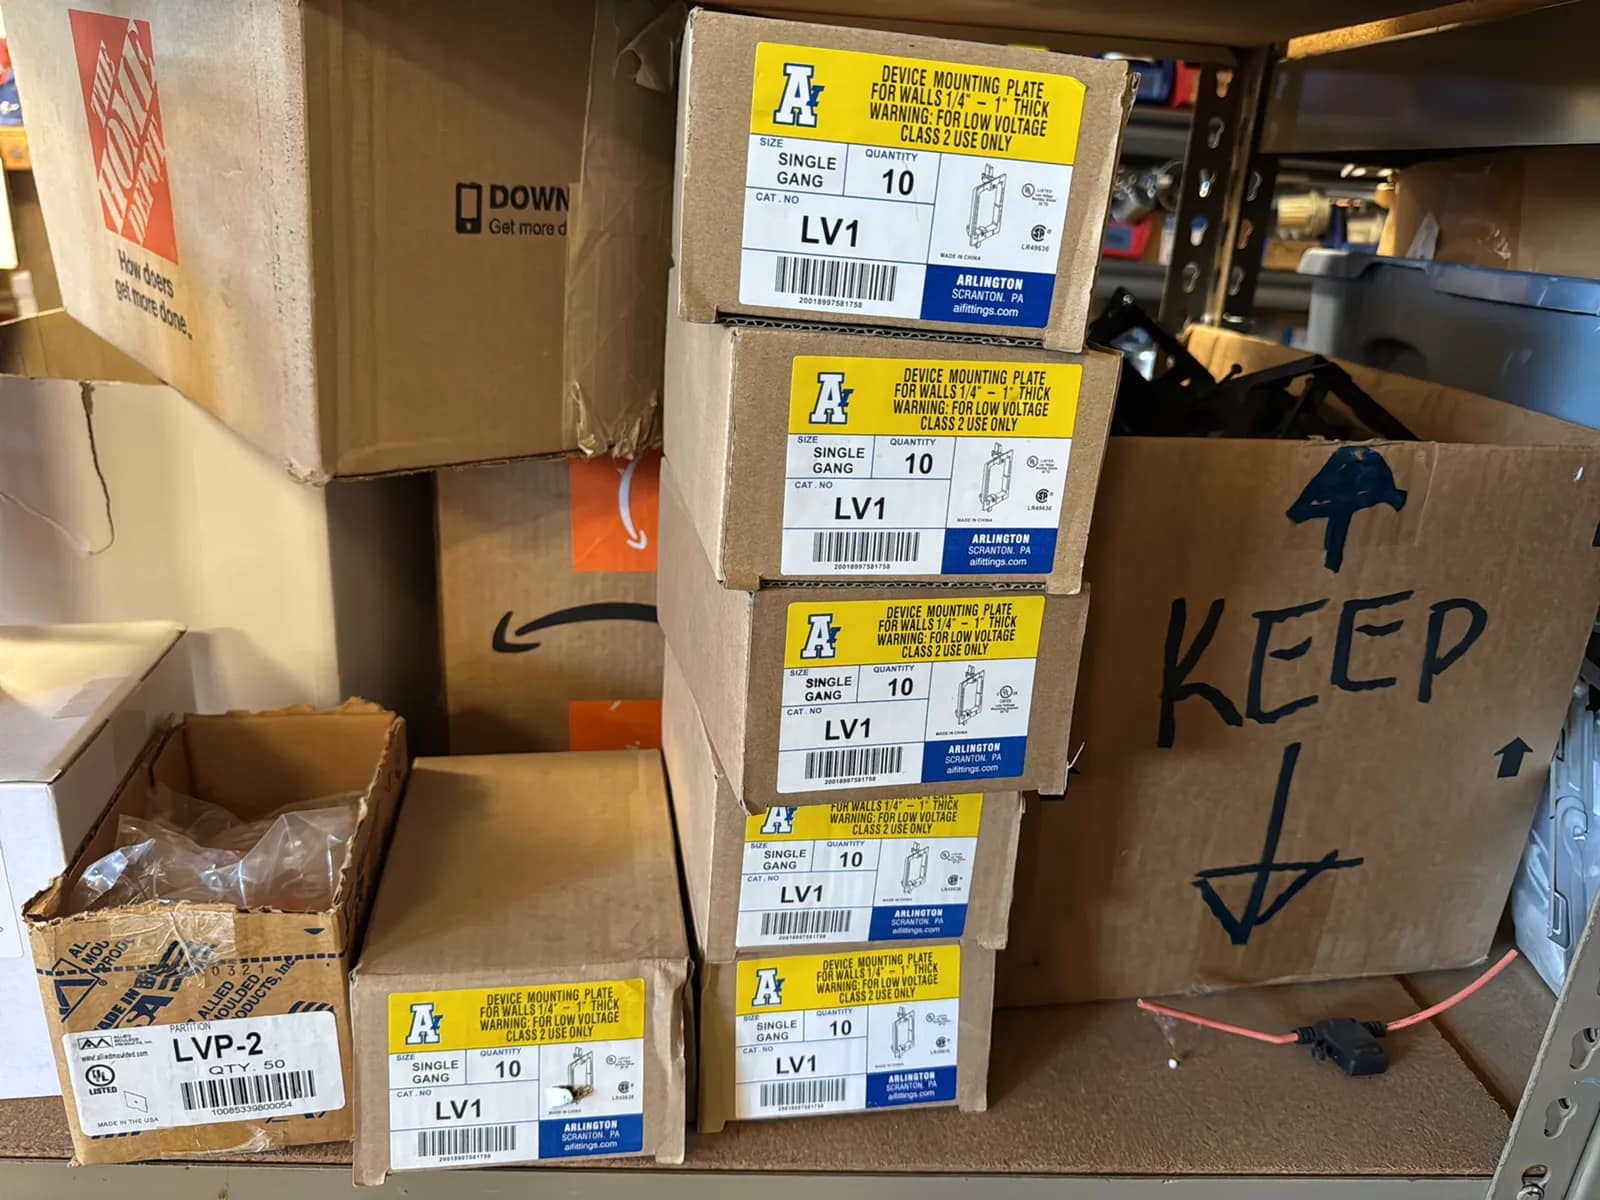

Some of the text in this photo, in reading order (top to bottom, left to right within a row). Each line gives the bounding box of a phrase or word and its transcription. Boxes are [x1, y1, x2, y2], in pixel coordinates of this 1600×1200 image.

[91, 39, 115, 128] THE
[881, 65, 1044, 99] DEVICE MOUNTING PLATE
[870, 83, 898, 102] FOR
[899, 86, 942, 106] WALLS
[1012, 98, 1049, 117] THICK
[98, 18, 158, 236] HOME
[869, 103, 1047, 136] WARNING: FOR LOW VOLTAGE
[759, 138, 783, 148] SIZE
[900, 125, 1012, 152] CLASS 2 USE ONLY
[778, 153, 837, 170] SINGLE
[864, 149, 917, 163] QUANTITY
[128, 113, 167, 246] DEPOT
[776, 171, 824, 187] GANG
[880, 168, 915, 195] 10
[490, 184, 569, 212] DOWN
[489, 218, 515, 234] Get
[520, 222, 554, 235] more
[801, 215, 858, 247] LV1
[118, 249, 174, 298] How doers
[956, 274, 1023, 290] ARLINGTON
[115, 279, 131, 302] get
[132, 288, 158, 318] more
[1011, 293, 1024, 303] PA
[952, 301, 1019, 318] aifittings.com
[903, 368, 1045, 385] DEVICE MOUNTING PLATE
[893, 400, 1048, 416] WARNING: FOR LOW VOLTAGE
[920, 416, 1018, 431] CLASS 2 USE ONLY
[889, 438, 935, 446] QUANTITY
[813, 447, 865, 458] SINGLE
[812, 463, 854, 473] GANG
[904, 453, 934, 473] 10
[835, 497, 885, 519] LV1
[971, 534, 1029, 543] ARLINGTON
[1019, 546, 1031, 554] PA
[968, 557, 1026, 566] aifittings.com
[885, 603, 1012, 618] DEVICE MOUNTING PLATE
[877, 629, 1015, 645] WARNING: FOR LOW VOLTAGE
[901, 643, 988, 658] CLASS 2 USE ONLY
[874, 665, 915, 673] QUANTITY
[1158, 590, 1487, 748] KEEP
[805, 677, 852, 687] SINGLE
[887, 678, 914, 696] 10
[804, 690, 842, 701] GANG
[825, 718, 870, 740] LV1
[948, 743, 1000, 753] ARLINGTON
[946, 762, 998, 773] aifittings.com
[829, 812, 957, 824] WARNING: FOR LOW VOLTAGE
[852, 824, 932, 834] CLASS 2 USE ONLY
[764, 850, 806, 858] SINGLE
[838, 851, 863, 867] 10
[762, 861, 797, 869] GANG
[780, 885, 822, 903] LV1
[894, 909, 943, 917] ARLINGTON
[823, 953, 933, 970] DEVICE MOUNTING PLATE
[198, 981, 234, 1019] ALLIED
[486, 988, 613, 1005] DEVICE MOUNTING PLATE
[839, 987, 915, 1002] CLASS 2 USE ONLY
[816, 1008, 851, 1016] QUANTITY
[170, 1022, 211, 1032] PARTITION
[757, 1020, 797, 1030] SINGLE
[829, 1019, 851, 1035] 10
[506, 1026, 593, 1041] CLASS 2 USE ONLY
[756, 1031, 789, 1041] GANG
[173, 1032, 263, 1062] LVP-2
[480, 1048, 520, 1057] QUANTITY
[209, 1059, 285, 1075] QTY. 50
[412, 1060, 458, 1071] SINGLE
[495, 1060, 520, 1078] 10
[777, 1054, 815, 1074] LV1
[412, 1073, 449, 1083] GANG
[888, 1072, 934, 1082] ARLINGTON
[89, 1086, 117, 1095] LISTED
[212, 1101, 292, 1116] 10085339800054
[436, 1099, 480, 1120] LV1
[564, 1120, 617, 1131] ARLINGTON
